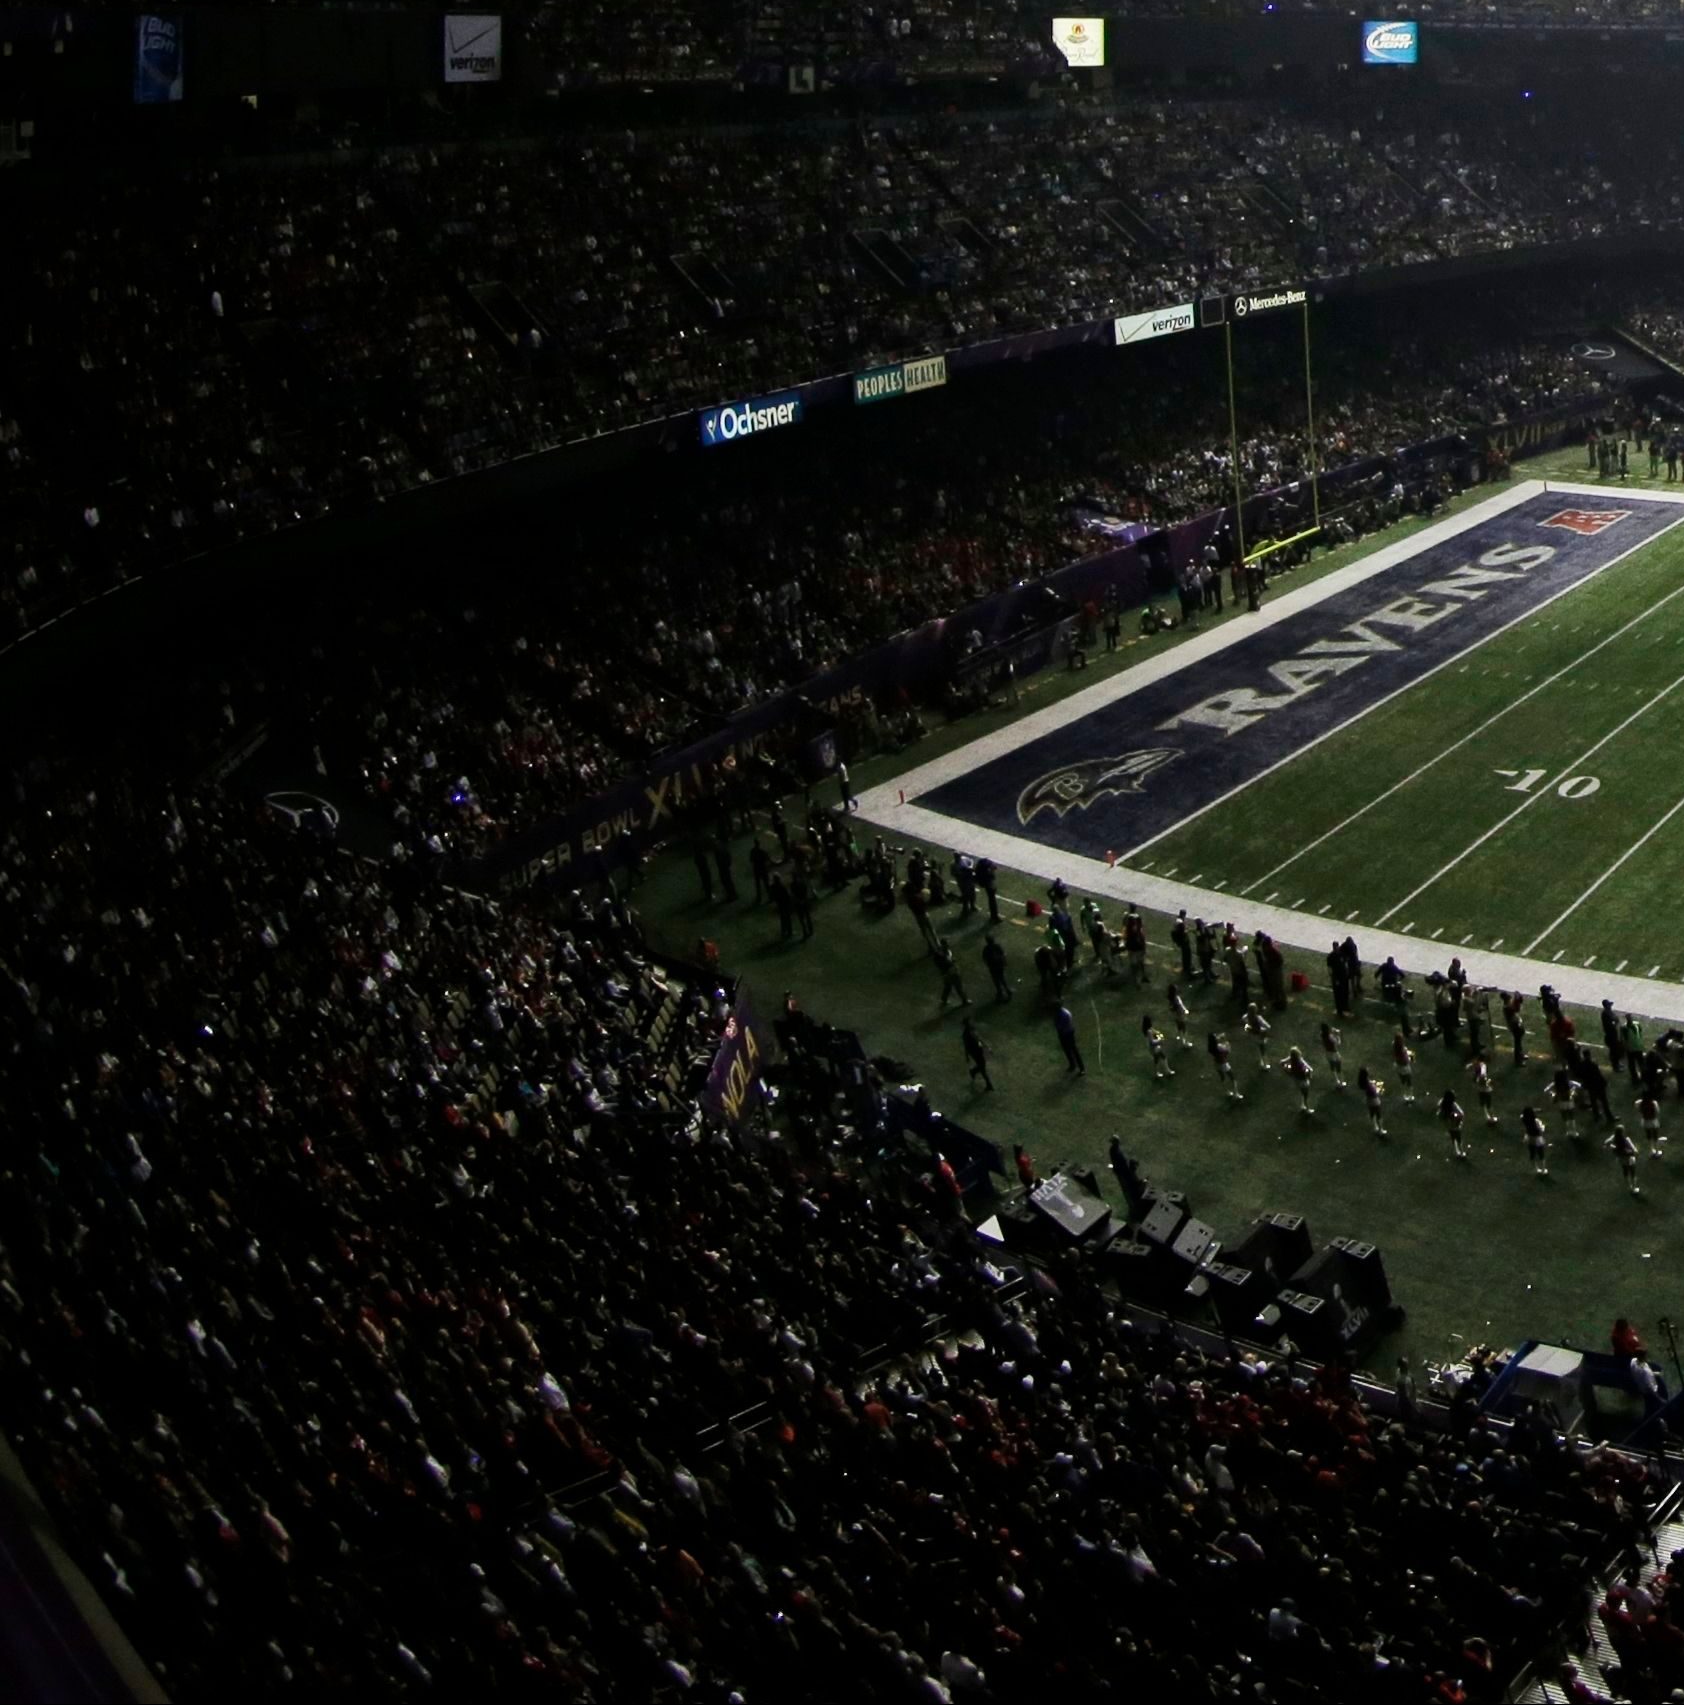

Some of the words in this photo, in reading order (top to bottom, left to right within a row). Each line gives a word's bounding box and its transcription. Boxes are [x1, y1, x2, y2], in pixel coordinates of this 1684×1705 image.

[150, 16, 176, 35] BUD
[450, 52, 495, 72] verizon
[1249, 290, 1307, 312] Mercedes-Benz
[1152, 313, 1191, 332] verizon
[856, 371, 904, 400] PEOPLES
[906, 359, 946, 387] HEALTH
[719, 400, 797, 440] Ochsner
[1156, 542, 1555, 736] RAVENS
[1505, 768, 1601, 798] 10
[721, 1026, 759, 1119] NOLA
